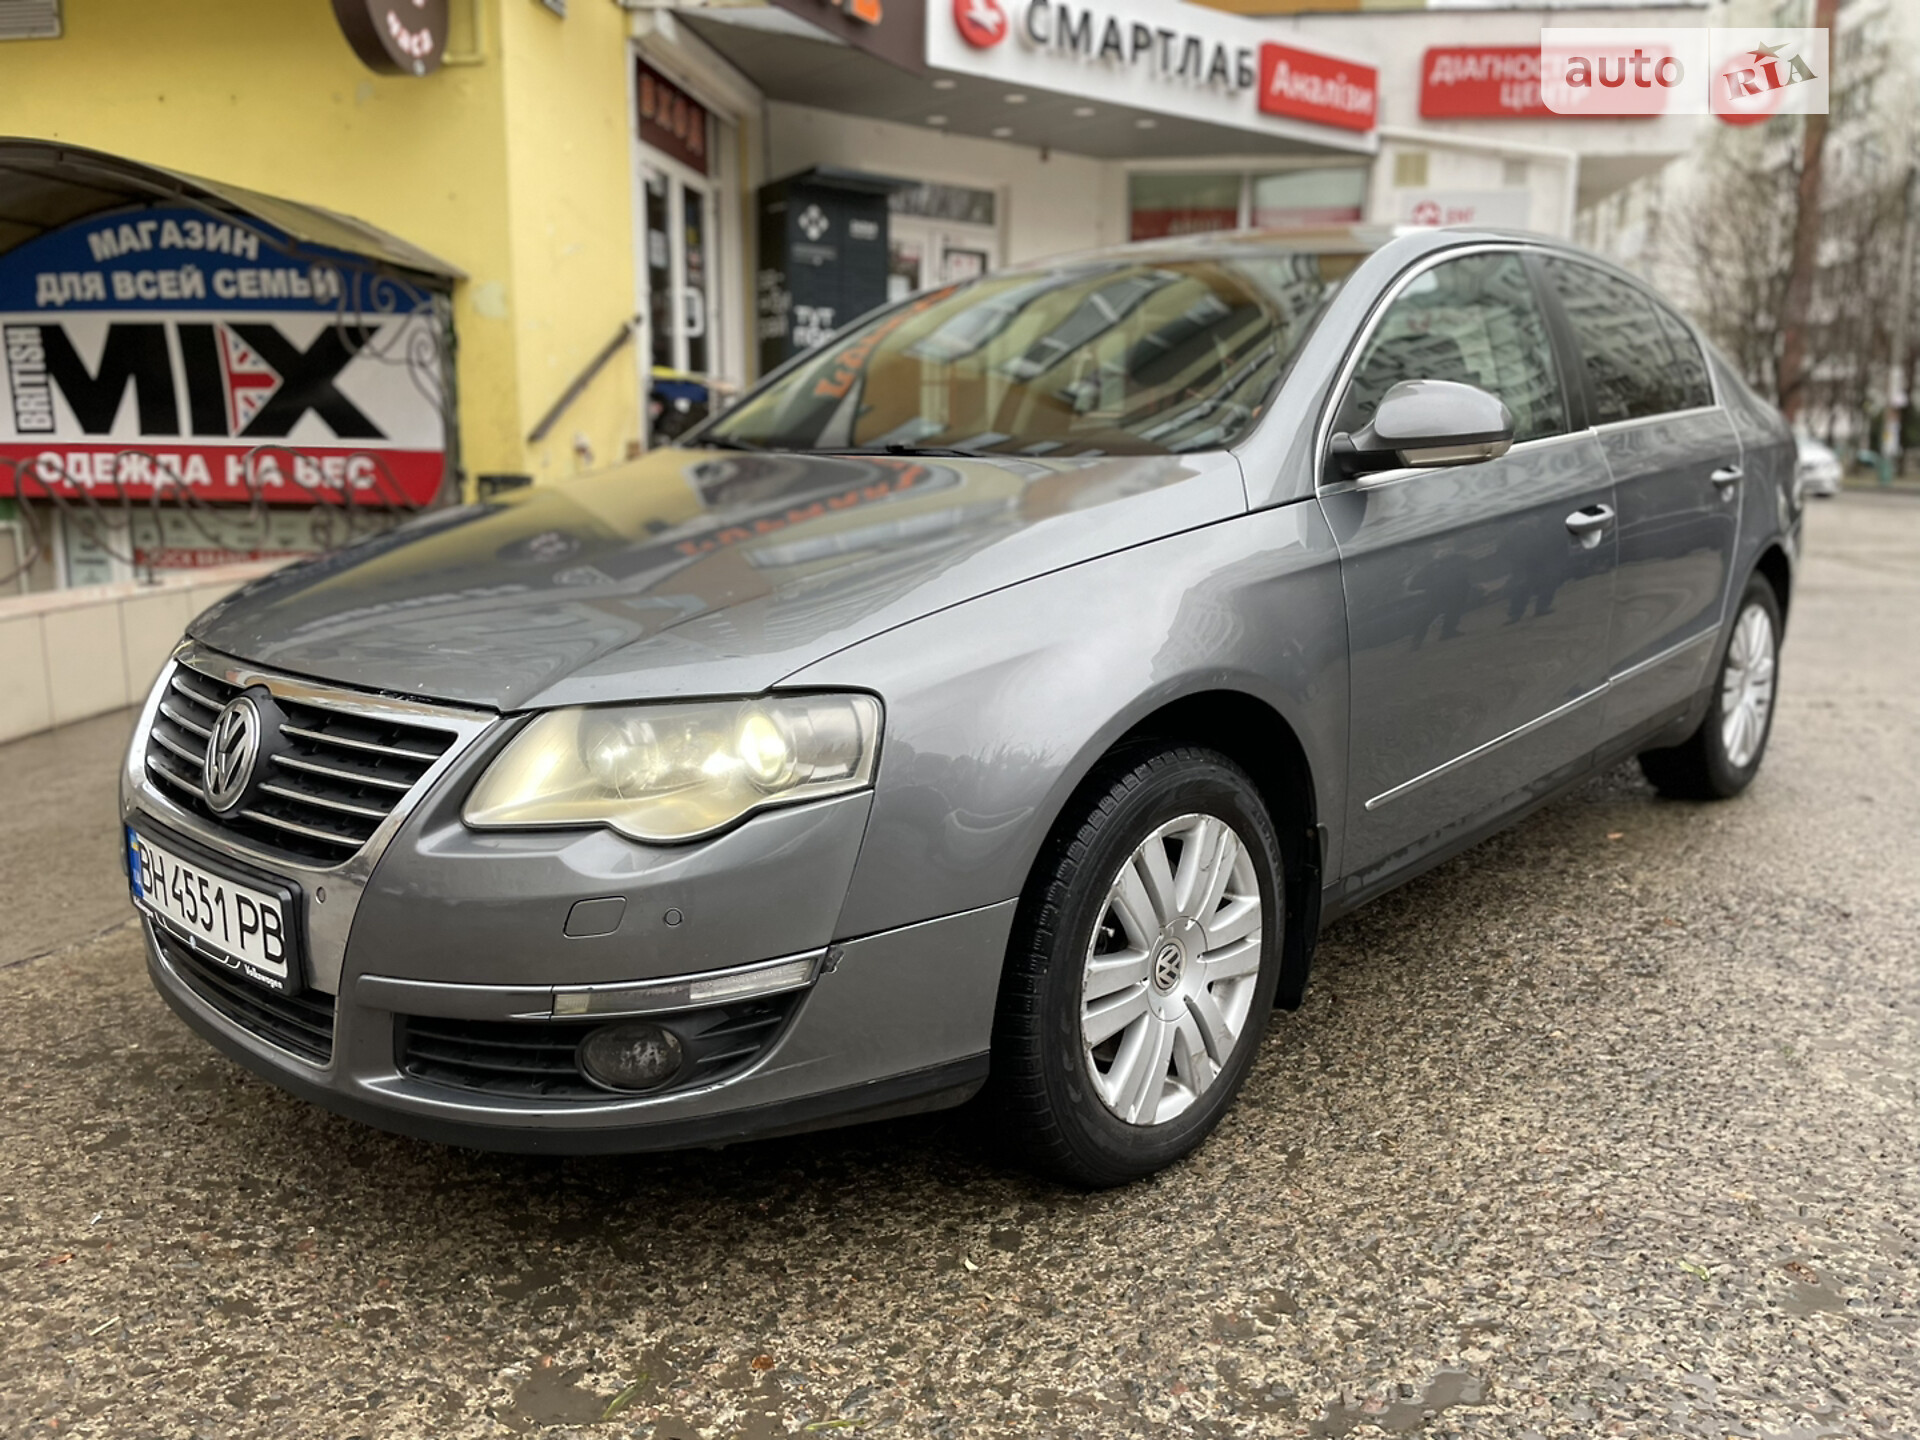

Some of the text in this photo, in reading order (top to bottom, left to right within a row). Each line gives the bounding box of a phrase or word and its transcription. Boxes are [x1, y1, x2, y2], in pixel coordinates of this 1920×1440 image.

[1026, 0, 1255, 89] СМАРТЛАБ
[1270, 59, 1375, 116] Аналізи
[88, 219, 260, 263] МАГАЗИН
[35, 265, 341, 307] ДЛЯ ВСЕЙ СЕМЬИ
[6, 325, 55, 433] BRITISH
[46, 323, 389, 439] MIX
[34, 450, 212, 490] ОДЕЖДА
[225, 454, 284, 487] НА
[140, 841, 169, 907] BH
[171, 864, 229, 942] 4551
